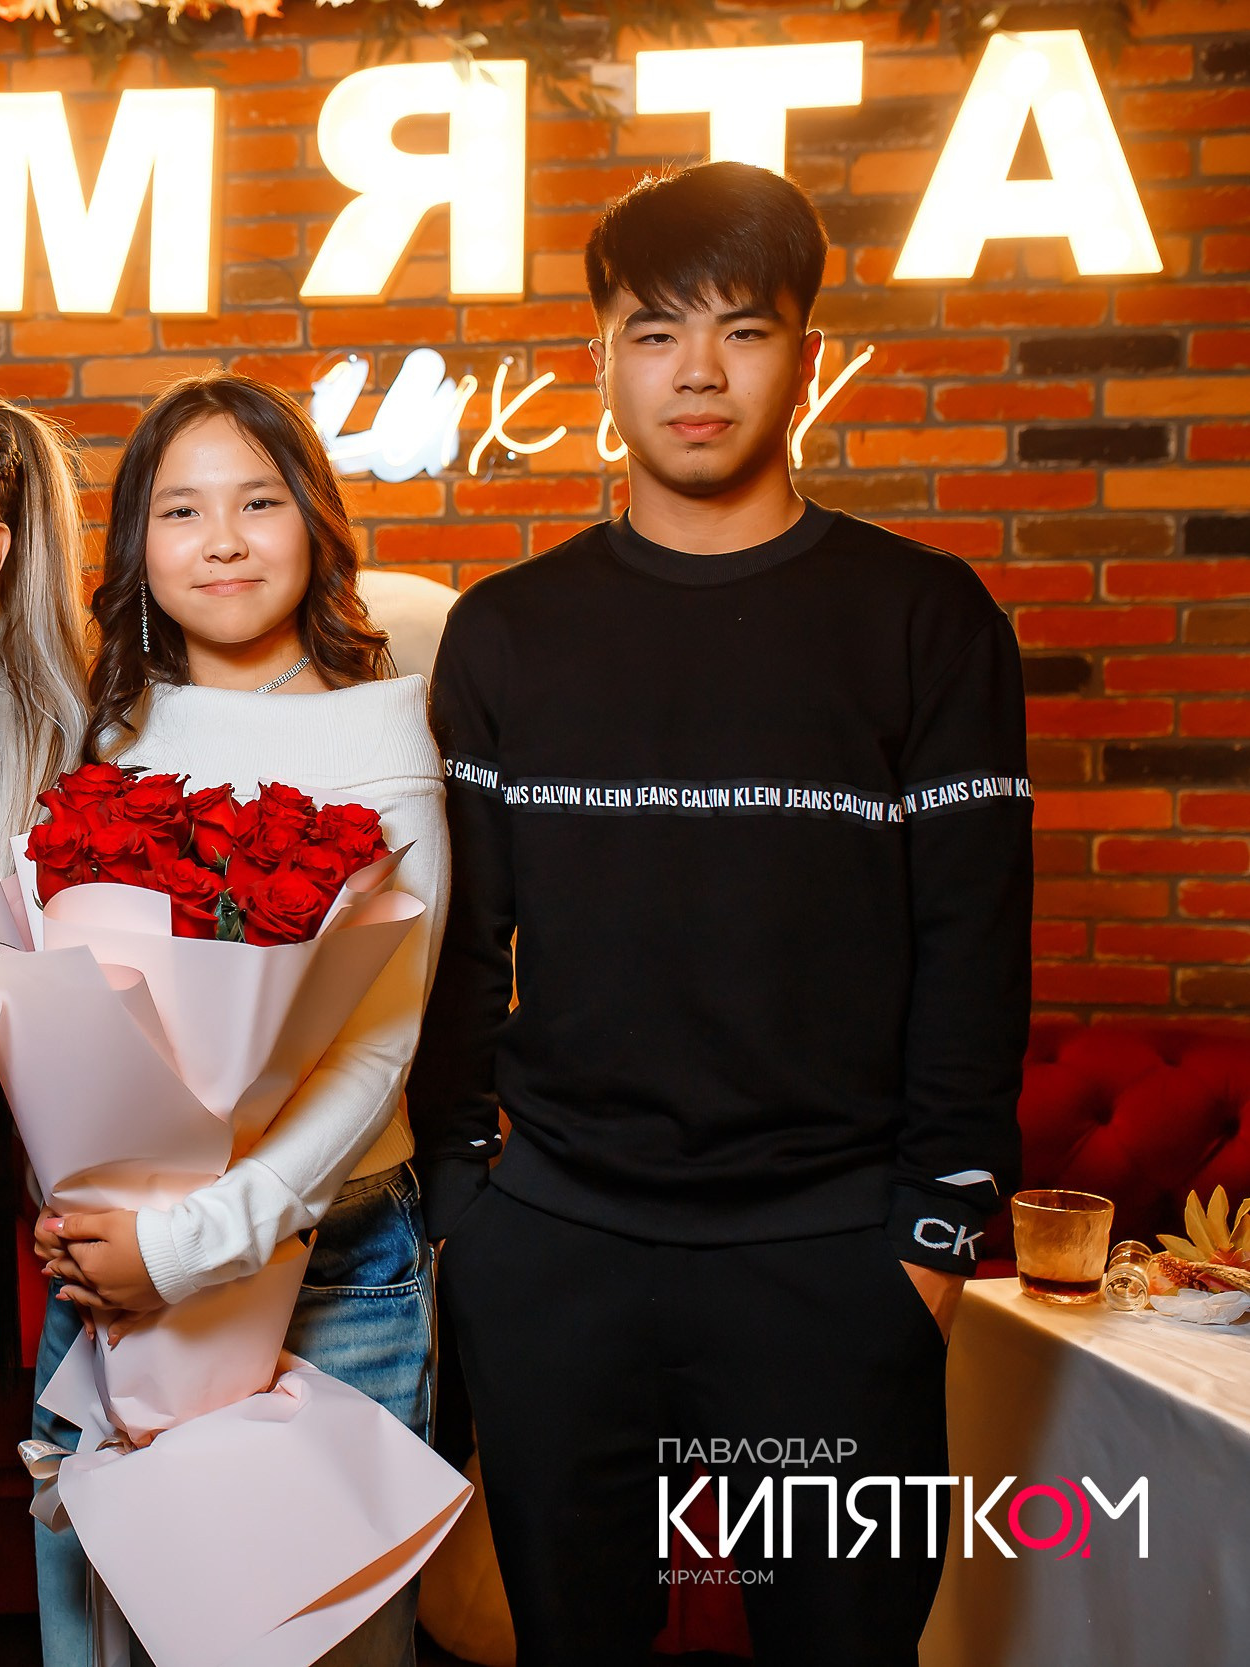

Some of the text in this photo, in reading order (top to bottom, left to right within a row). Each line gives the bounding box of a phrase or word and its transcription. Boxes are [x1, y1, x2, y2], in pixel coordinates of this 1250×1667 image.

[455, 761, 499, 789] CALVIN
[532, 786, 581, 805] CALVIN
[585, 788, 632, 808] KLEIN
[635, 786, 678, 807] JEANS
[681, 788, 730, 809] CALVIN
[734, 786, 781, 807] KLEIN
[784, 788, 831, 811] JEANS
[833, 792, 884, 821] CALVIN
[921, 782, 970, 811] JEANS
[972, 776, 1012, 798] CALVIN
[1016, 778, 1034, 800] KL
[913, 1217, 985, 1261] CK
